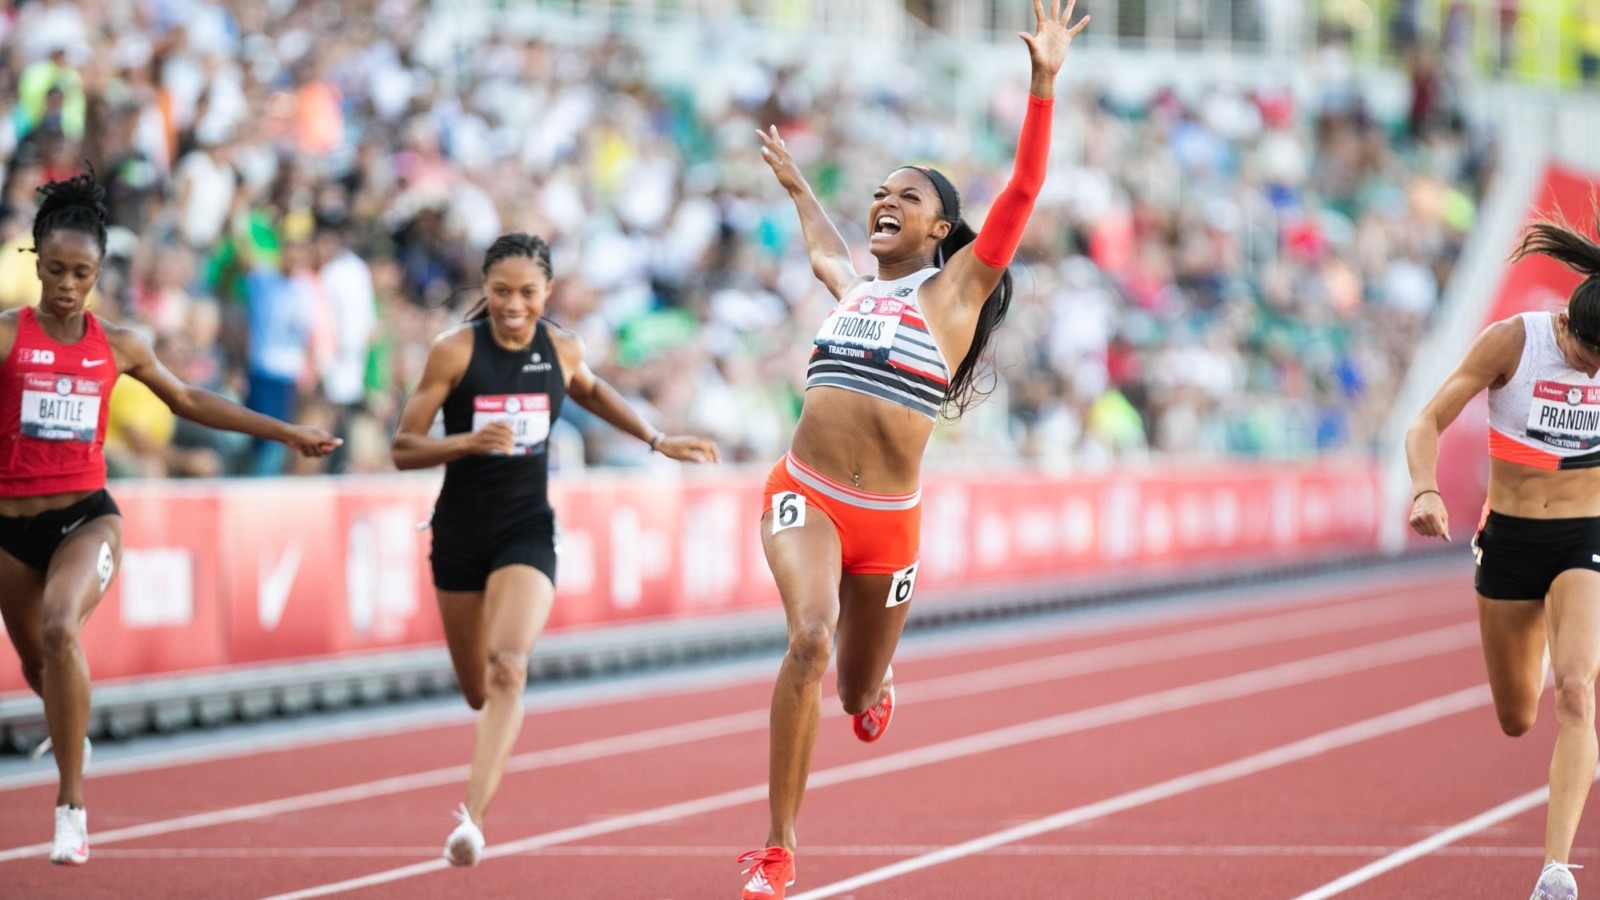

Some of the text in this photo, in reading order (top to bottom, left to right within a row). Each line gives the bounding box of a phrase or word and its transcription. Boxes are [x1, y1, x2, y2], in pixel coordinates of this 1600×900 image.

[832, 316, 885, 341] THOMAS
[39, 398, 85, 422] BATTLE
[1540, 404, 1600, 431] PRANDINI
[779, 493, 799, 527] 6
[895, 566, 914, 603] 6
